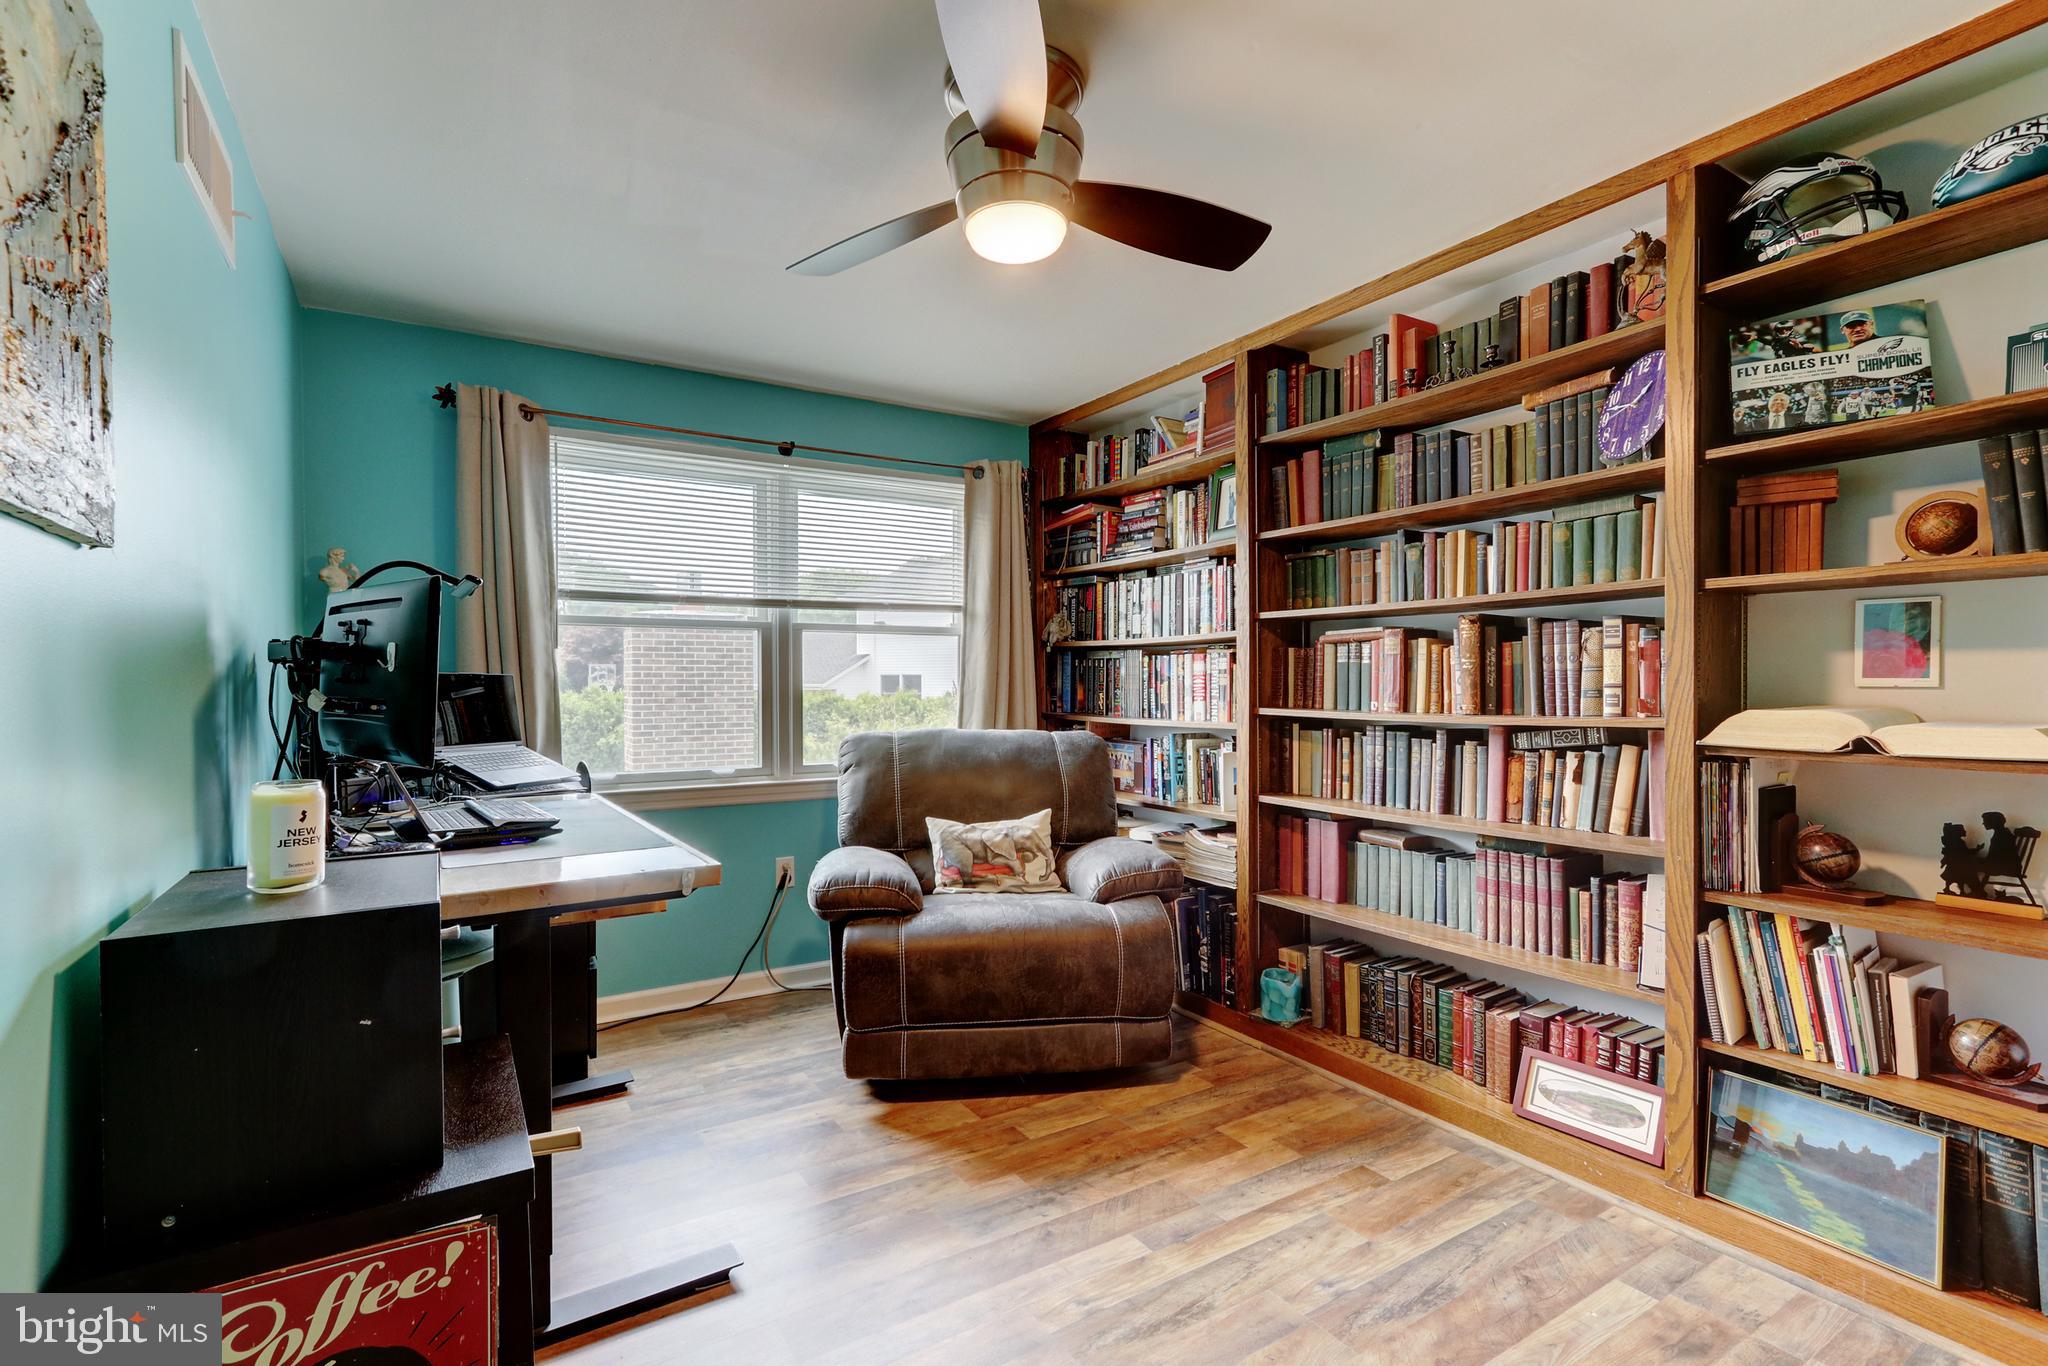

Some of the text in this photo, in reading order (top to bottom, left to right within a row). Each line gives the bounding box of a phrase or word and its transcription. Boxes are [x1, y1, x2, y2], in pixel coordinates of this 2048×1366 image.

[1785, 229, 1820, 247] Ridell
[1638, 358, 1652, 376] 12
[1737, 365, 1761, 378] FLY
[1764, 357, 1816, 374] EAGLES
[1820, 353, 1850, 367] FLY!
[1858, 353, 1922, 373] CHAMPIONS
[1623, 370, 1633, 388] 11
[1609, 390, 1620, 407] 10
[1602, 412, 1610, 427] 9
[1655, 404, 1664, 420] 4
[1603, 427, 1610, 442] 8
[1641, 424, 1649, 439] 5
[1611, 438, 1619, 453] 7
[1623, 437, 1632, 453] 6
[1210, 698, 1219, 723] KING
[287, 826, 317, 837] NEW
[277, 836, 321, 848] JERSEY
[222, 1241, 464, 1366] Coffee!
